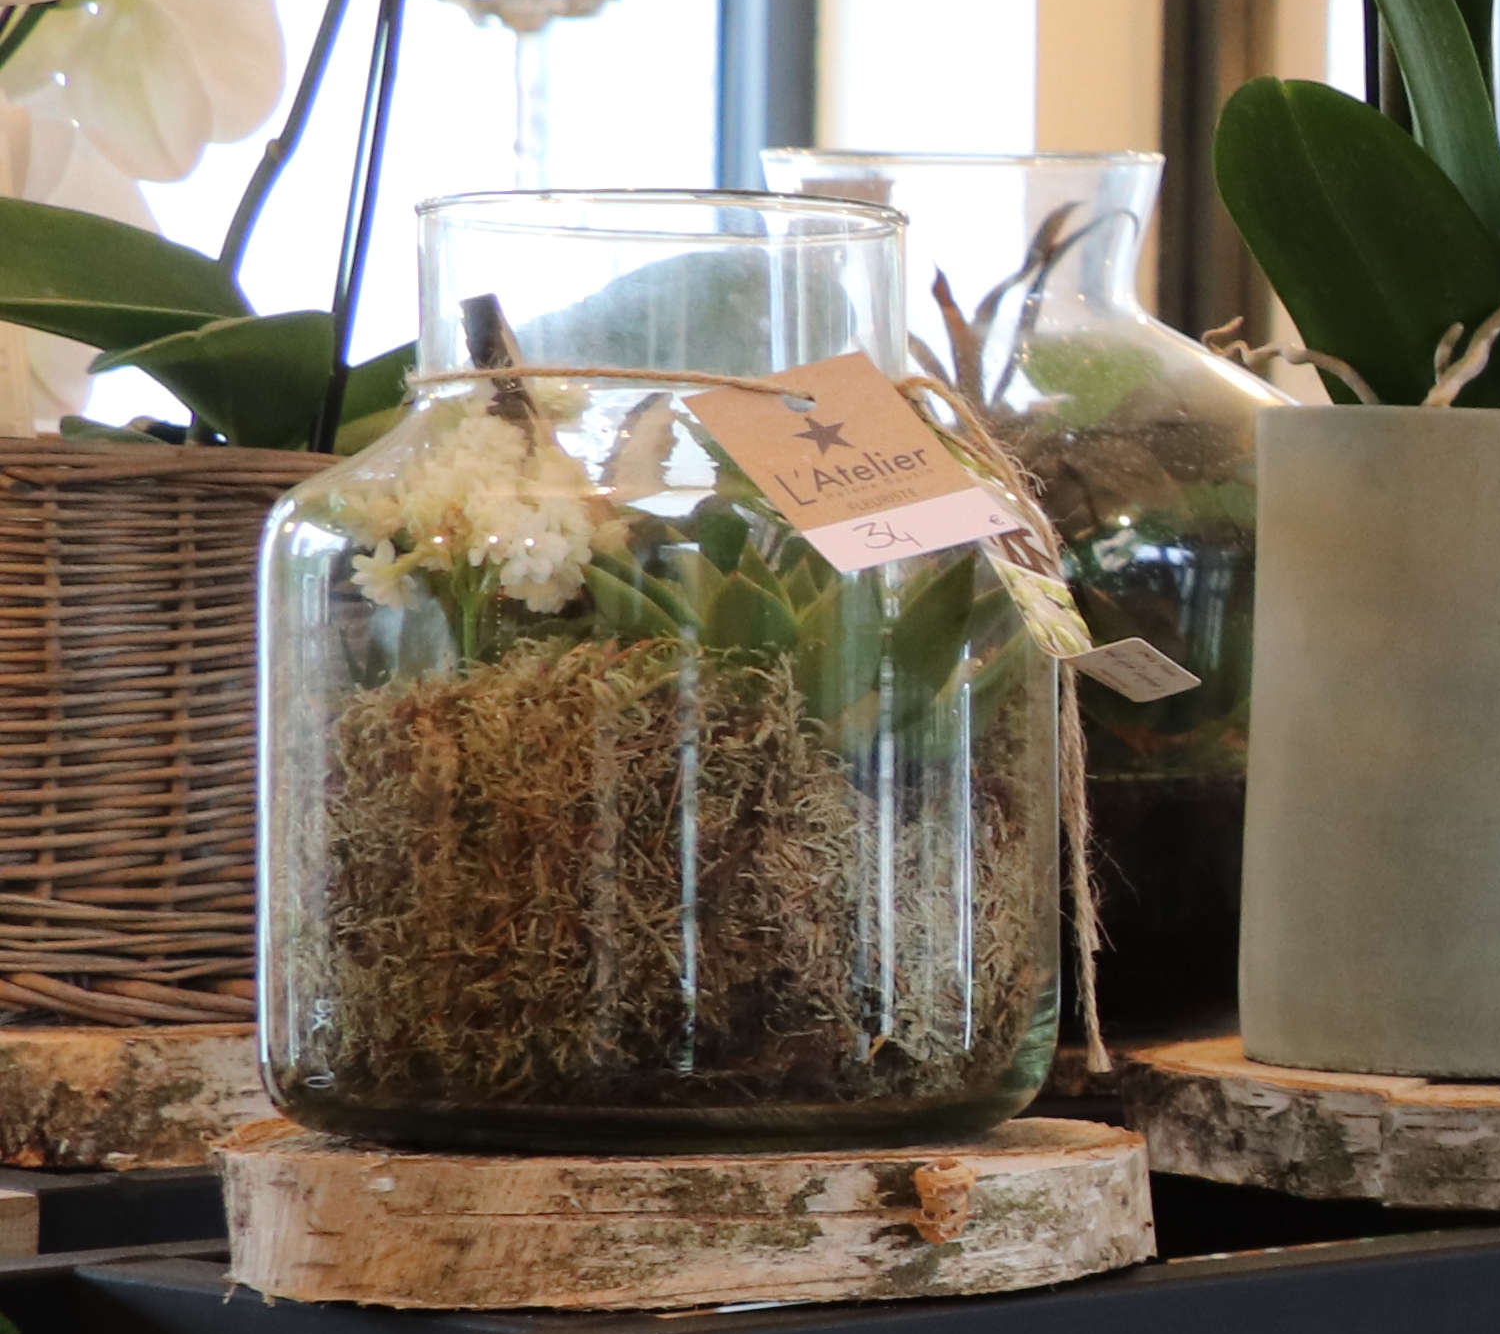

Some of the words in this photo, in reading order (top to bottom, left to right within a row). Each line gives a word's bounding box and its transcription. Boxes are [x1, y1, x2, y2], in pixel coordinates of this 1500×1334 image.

[773, 447, 929, 506] L'Atelier
[849, 487, 919, 511] FLEURISTE
[852, 521, 923, 549] 34
